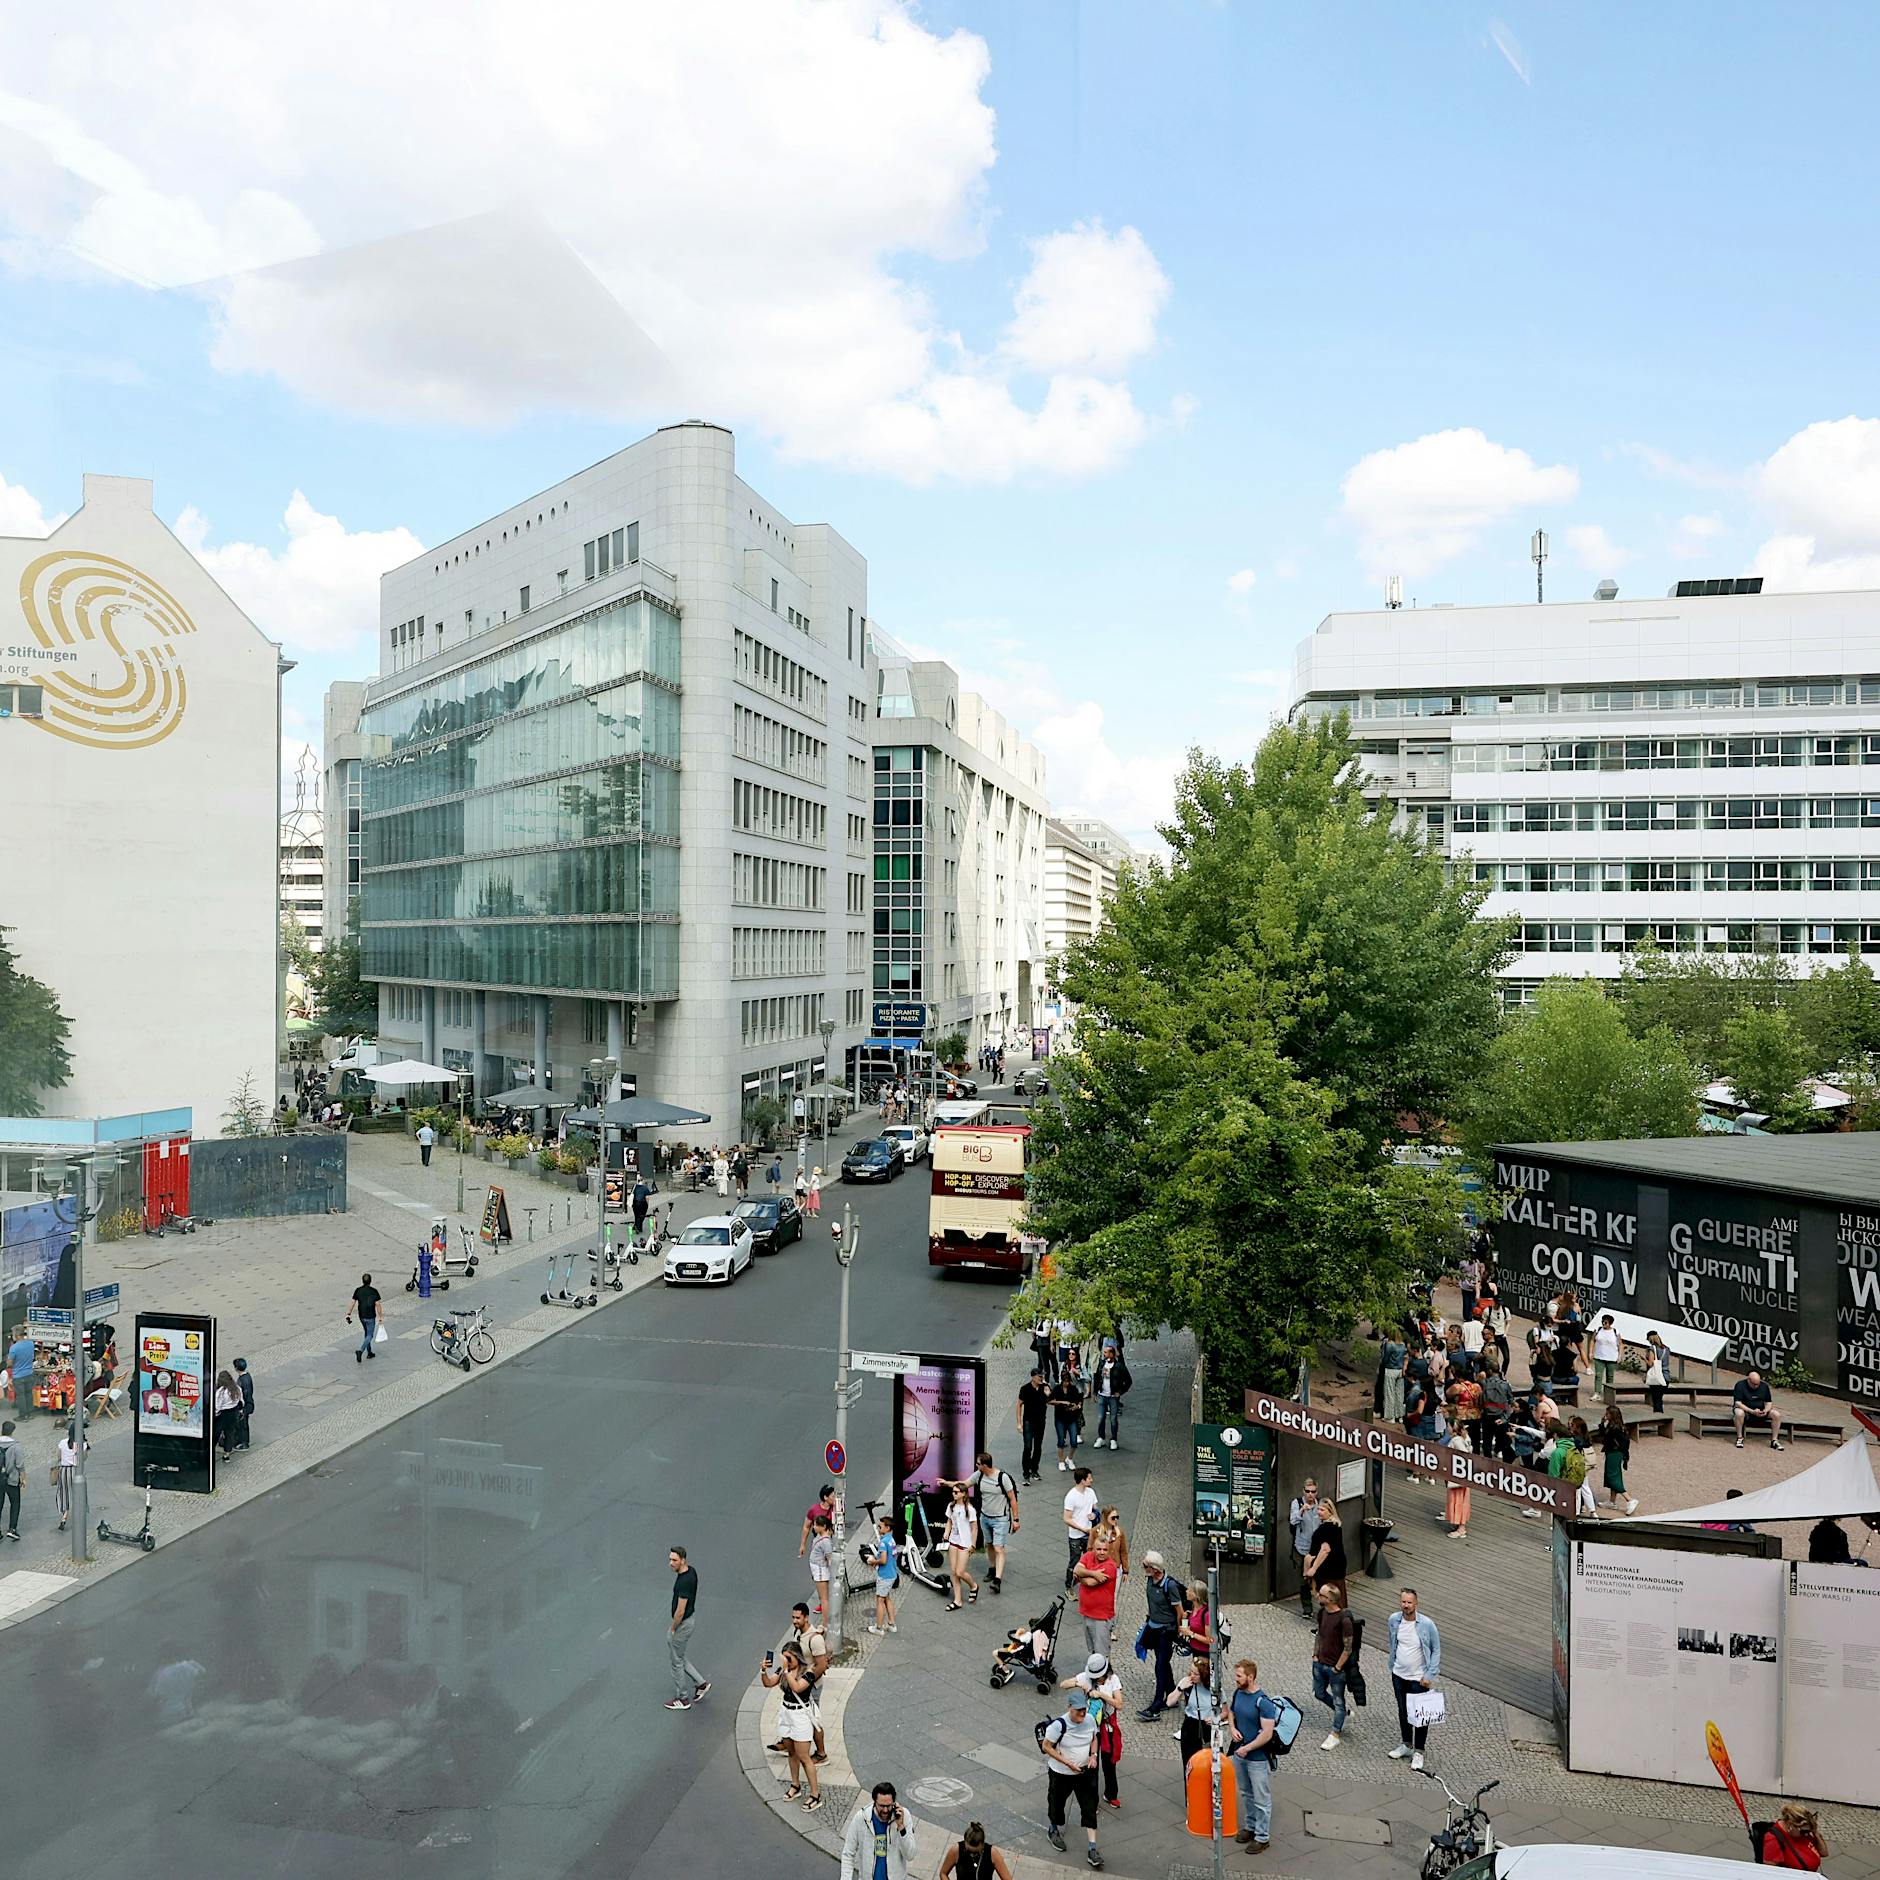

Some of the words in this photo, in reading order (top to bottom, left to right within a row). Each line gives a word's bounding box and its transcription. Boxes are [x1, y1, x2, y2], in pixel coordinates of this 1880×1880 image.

[7, 646, 77, 663] Stiftungen
[963, 1145, 979, 1153] BIG
[975, 1175, 1009, 1183] DISCOVER
[977, 1181, 1009, 1190] EXPLORE
[1497, 1162, 1550, 1192] МИР
[1502, 1196, 1598, 1238] KALTER
[1698, 1218, 1791, 1254] GUERRE
[1531, 1243, 1614, 1289] COLD
[1682, 1254, 1761, 1286] CURTAIN
[1496, 1267, 1517, 1282] YOU
[1519, 1272, 1539, 1286] ARE
[1586, 1287, 1608, 1303] THE
[1496, 1279, 1549, 1300] AMERICAN
[1741, 1286, 1797, 1312] NUCLE
[31, 1329, 69, 1340] Zimmerstraße
[862, 1356, 909, 1370] Zimmerstraße
[1725, 1340, 1784, 1371] EACE
[1258, 1398, 1361, 1448] Checkpoint
[1367, 1430, 1438, 1471] Charlie
[1452, 1454, 1556, 1507] BlackBox
[1585, 1564, 1640, 1574] INTERNATIONALE
[1585, 1571, 1684, 1586] ABRÜSTUNGSVERHANDLUNGEN
[1585, 1579, 1635, 1589] INTERNATIONAL
[1637, 1584, 1683, 1593] DISARMAMENT
[1585, 1586, 1631, 1596] NEGOTIATIONS
[1799, 1591, 1820, 1599] PROXY
[1821, 1593, 1841, 1601] WARS
